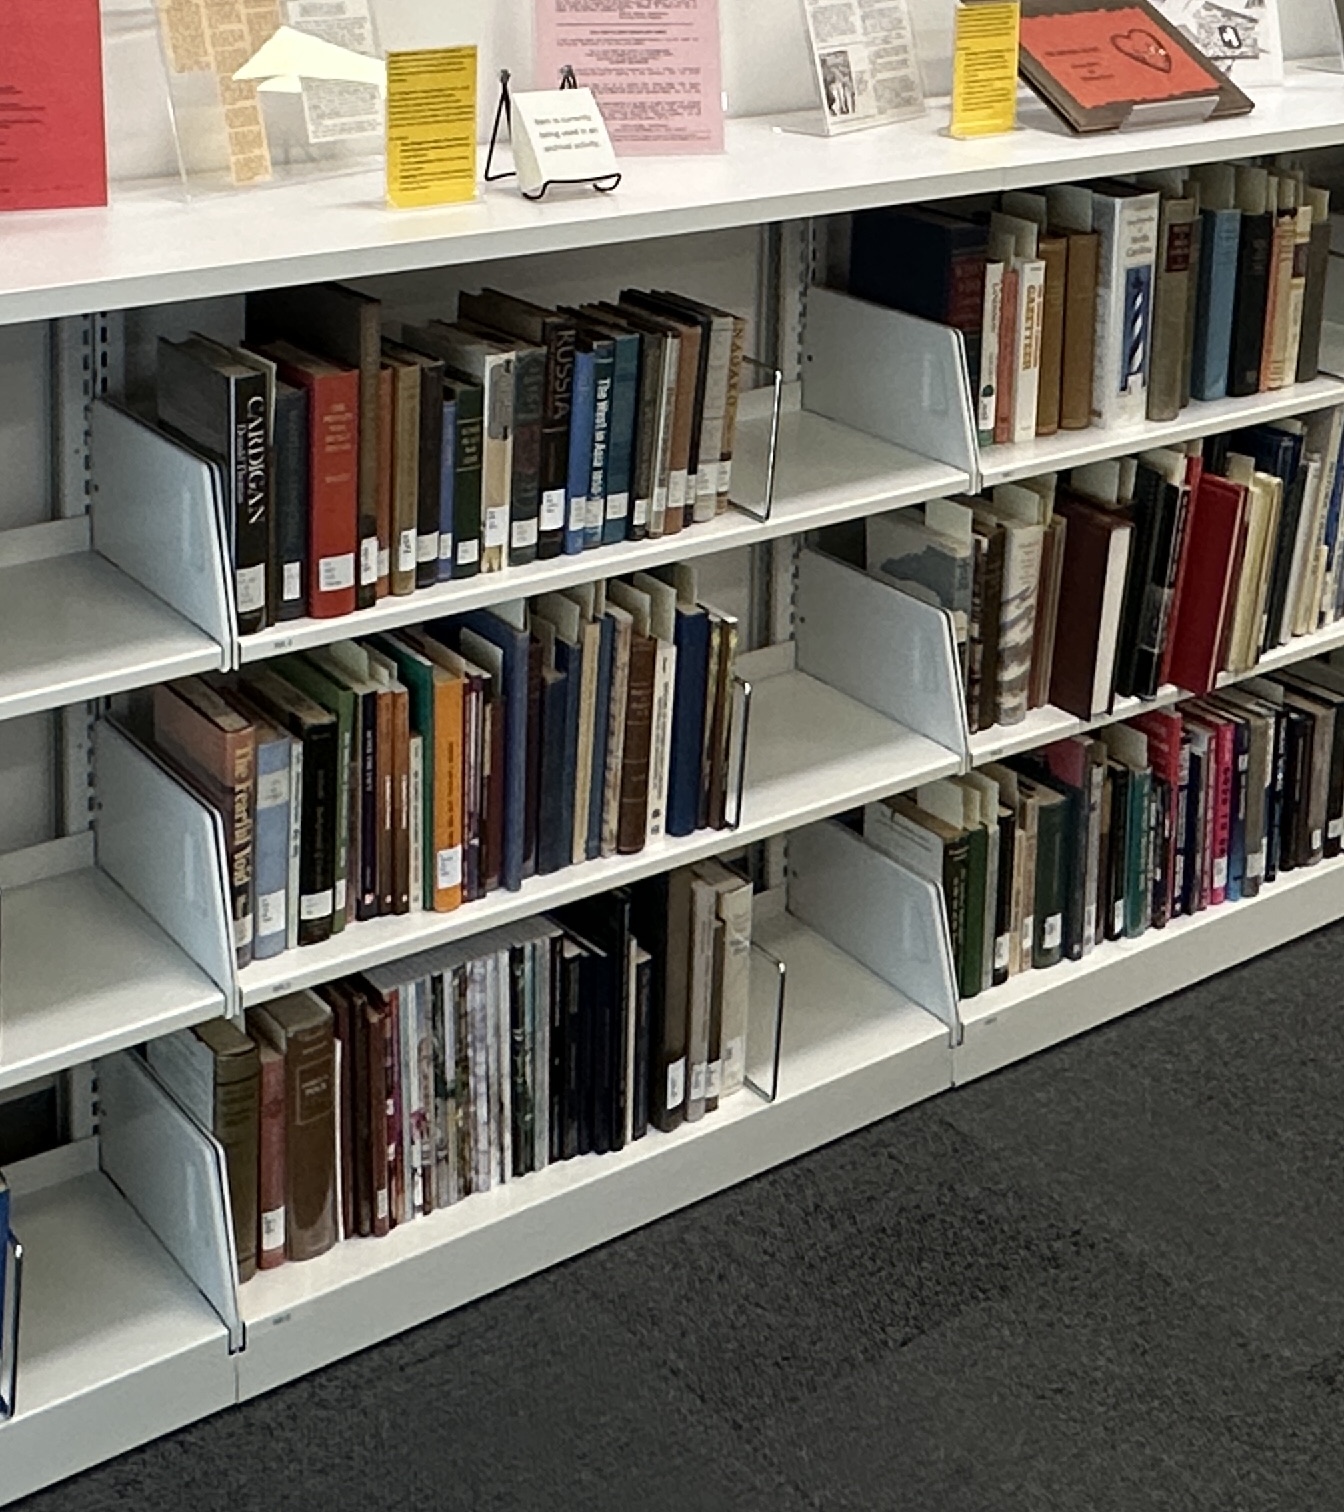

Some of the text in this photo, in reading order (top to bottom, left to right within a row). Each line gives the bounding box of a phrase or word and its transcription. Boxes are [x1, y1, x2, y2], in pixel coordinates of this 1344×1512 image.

[551, 330, 575, 420] RUSSIA
[591, 377, 611, 468] The West in Asia
[245, 395, 265, 525] CARDIGAN
[231, 745, 253, 888] The Fearful Void
